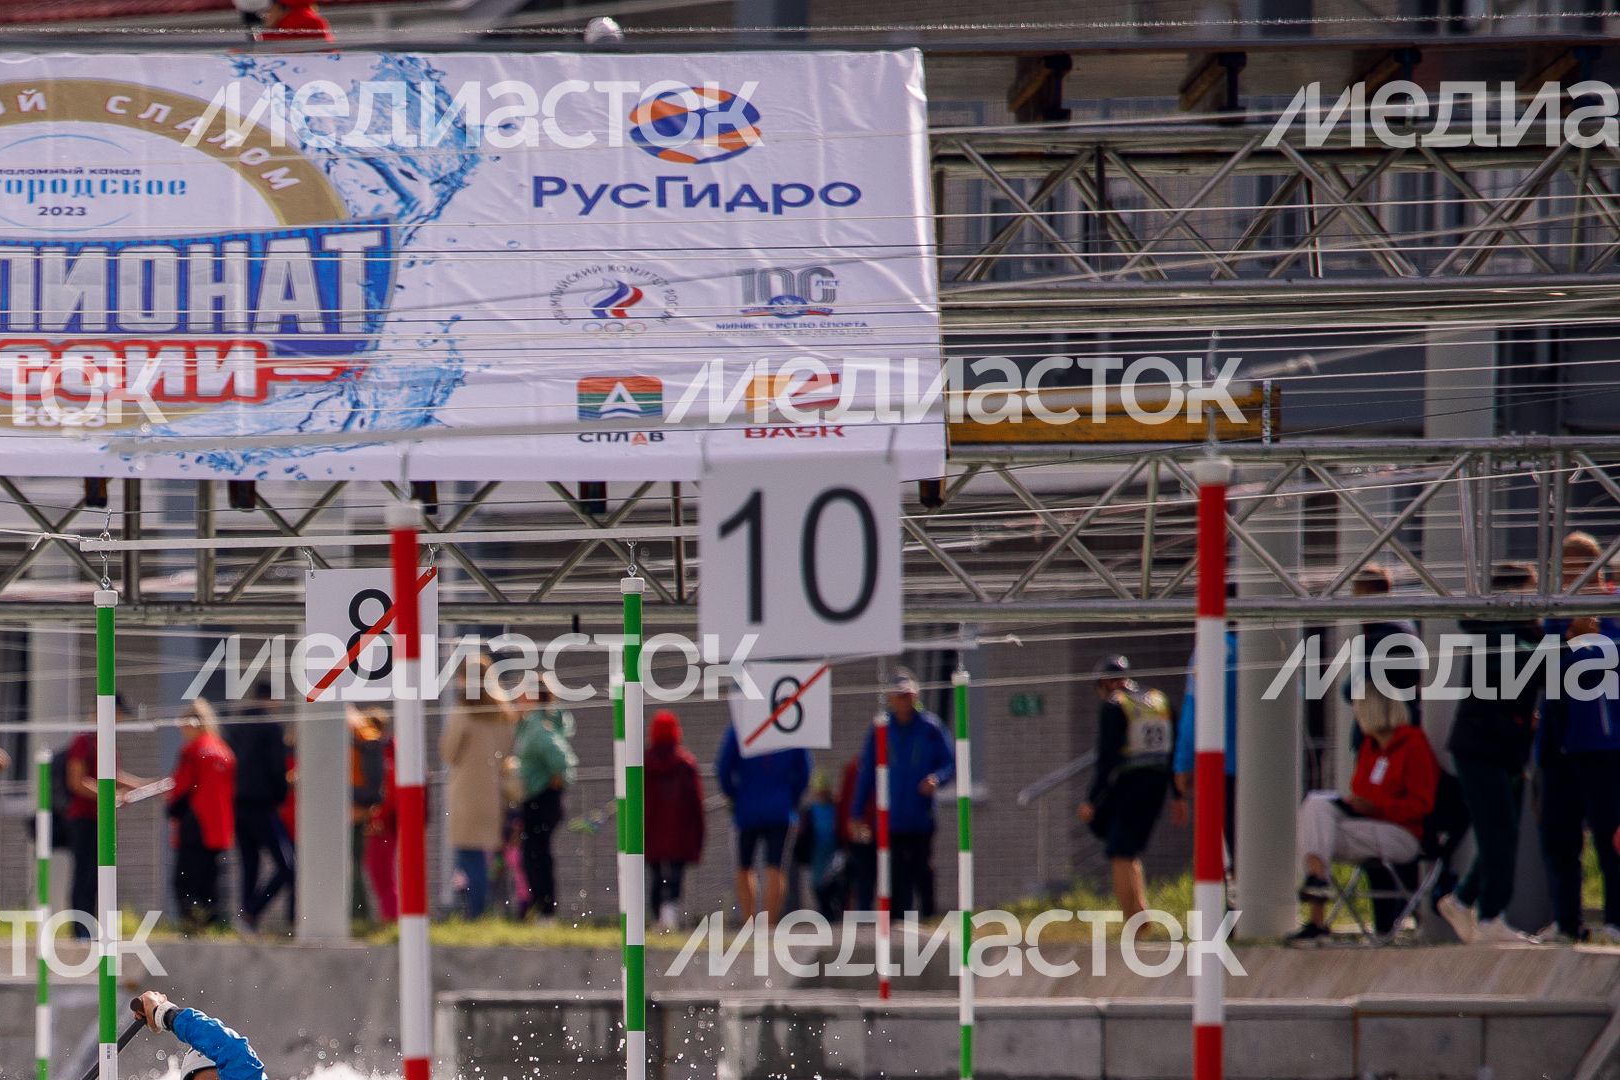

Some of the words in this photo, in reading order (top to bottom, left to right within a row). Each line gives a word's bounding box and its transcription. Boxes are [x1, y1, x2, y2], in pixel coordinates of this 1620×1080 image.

[105, 95, 302, 192] СЛАЛОМ
[89, 167, 142, 176] канал
[38, 206, 88, 217] 2023
[532, 175, 863, 216] РусГидро
[577, 430, 665, 446] СПЛАВ
[744, 425, 846, 439] BASK
[715, 486, 881, 625] 10
[347, 588, 395, 682] 8
[769, 676, 805, 733] 6
